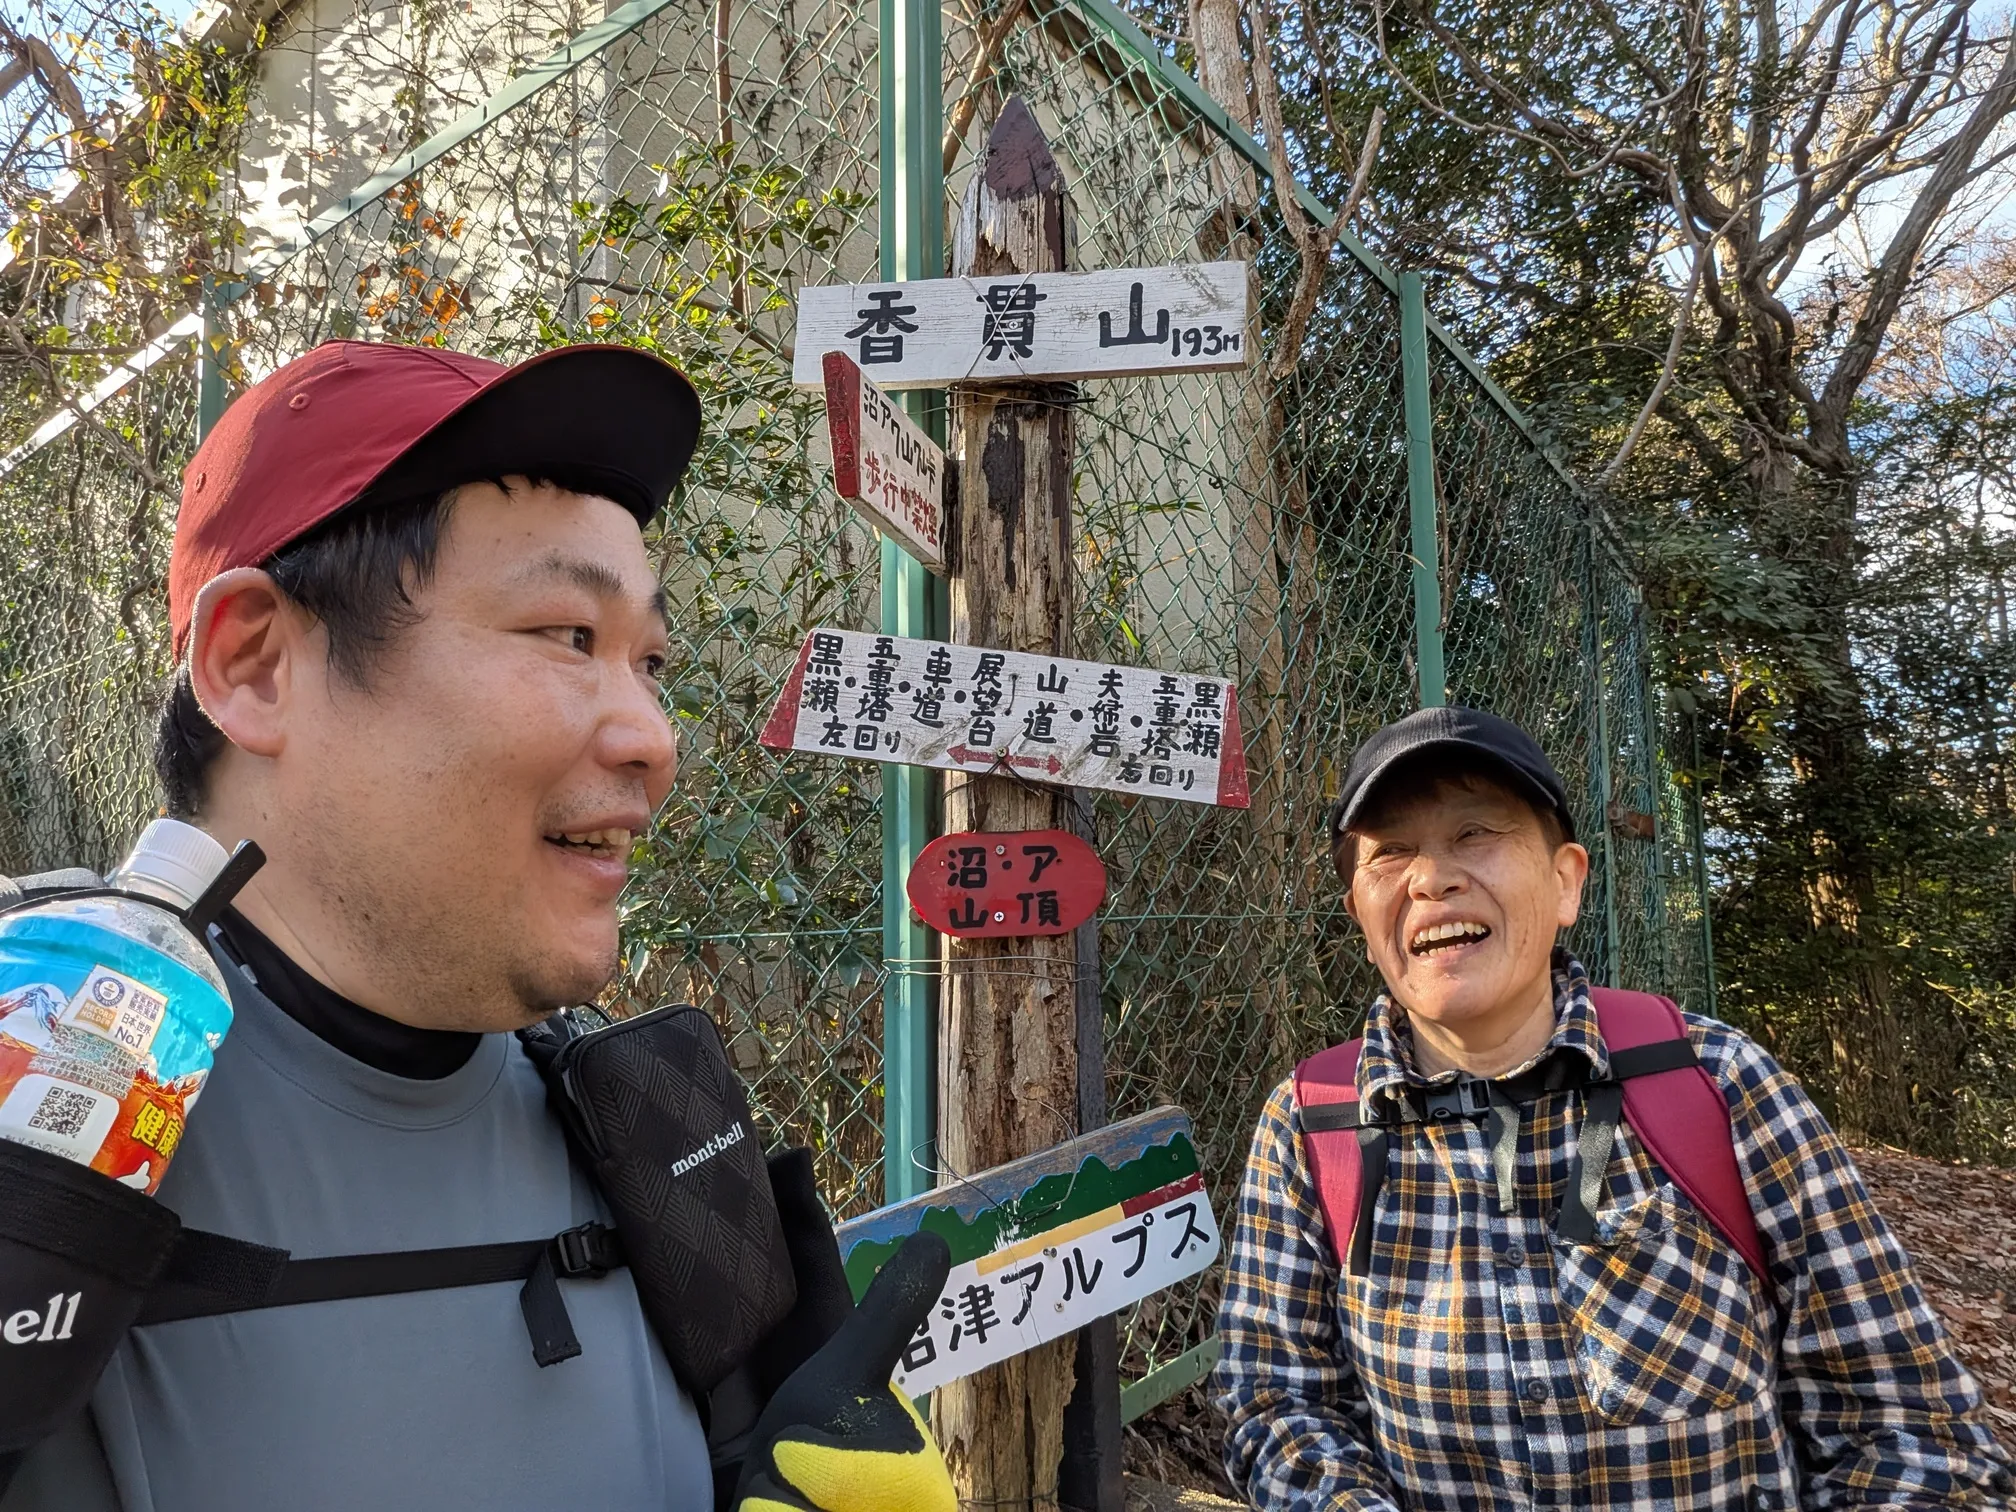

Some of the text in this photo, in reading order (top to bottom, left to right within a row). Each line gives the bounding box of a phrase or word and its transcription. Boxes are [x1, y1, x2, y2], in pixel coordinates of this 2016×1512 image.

[844, 281, 1170, 365] 香貫山
[819, 715, 901, 754] 左回り
[949, 890, 1062, 929] 山頂
[80, 1009, 111, 1026] HOLDER
[84, 1001, 115, 1020] RECORD
[114, 1025, 144, 1049] No.1
[0, 1291, 82, 1344] ell
